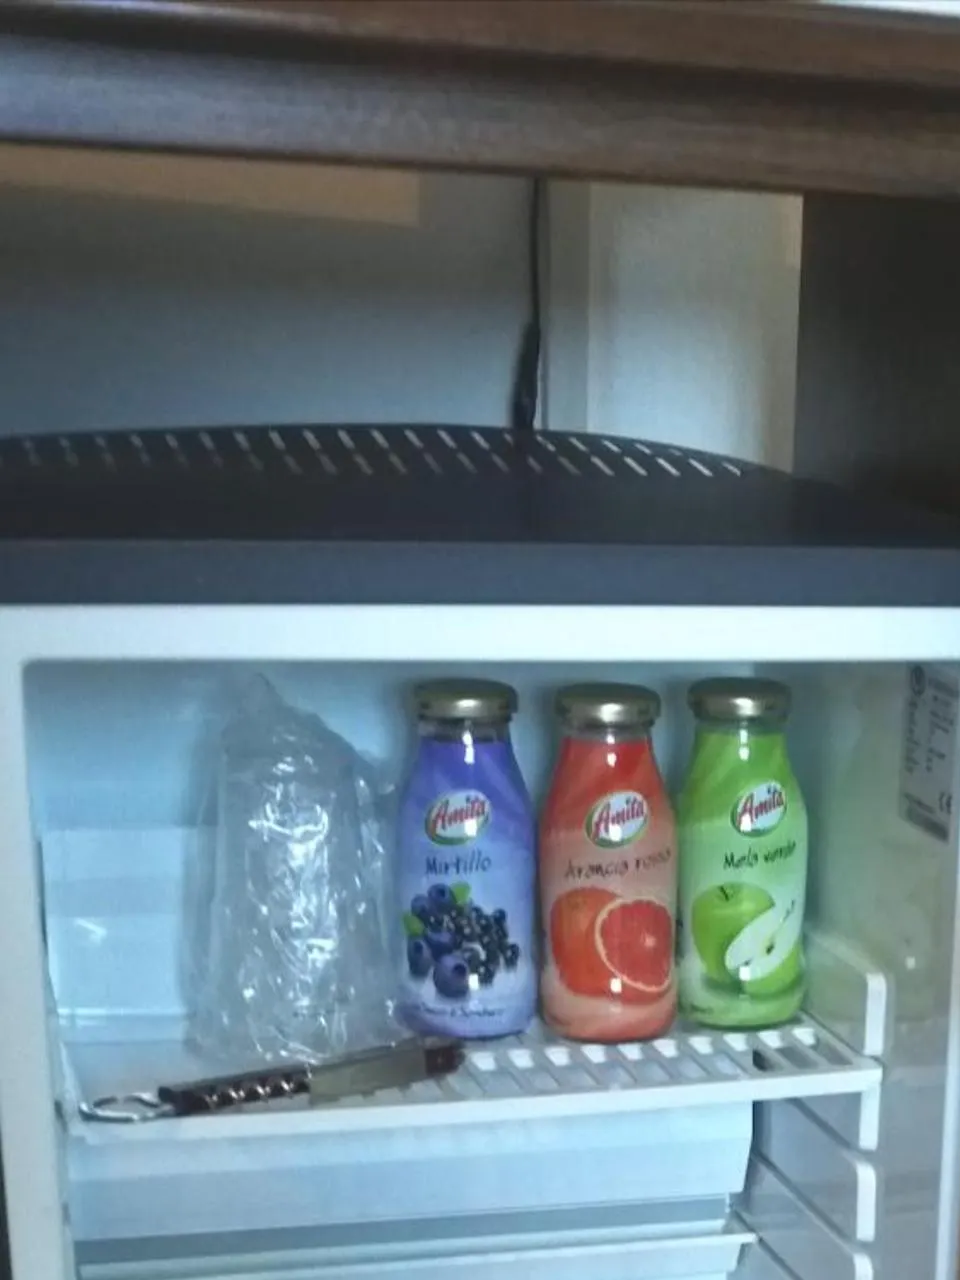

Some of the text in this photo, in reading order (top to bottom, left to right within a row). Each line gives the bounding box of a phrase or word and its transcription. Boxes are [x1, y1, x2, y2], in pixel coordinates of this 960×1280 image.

[432, 796, 486, 838] Amita
[592, 797, 645, 839] Amita
[736, 785, 784, 828] Amita
[425, 851, 492, 877] Mirtillo
